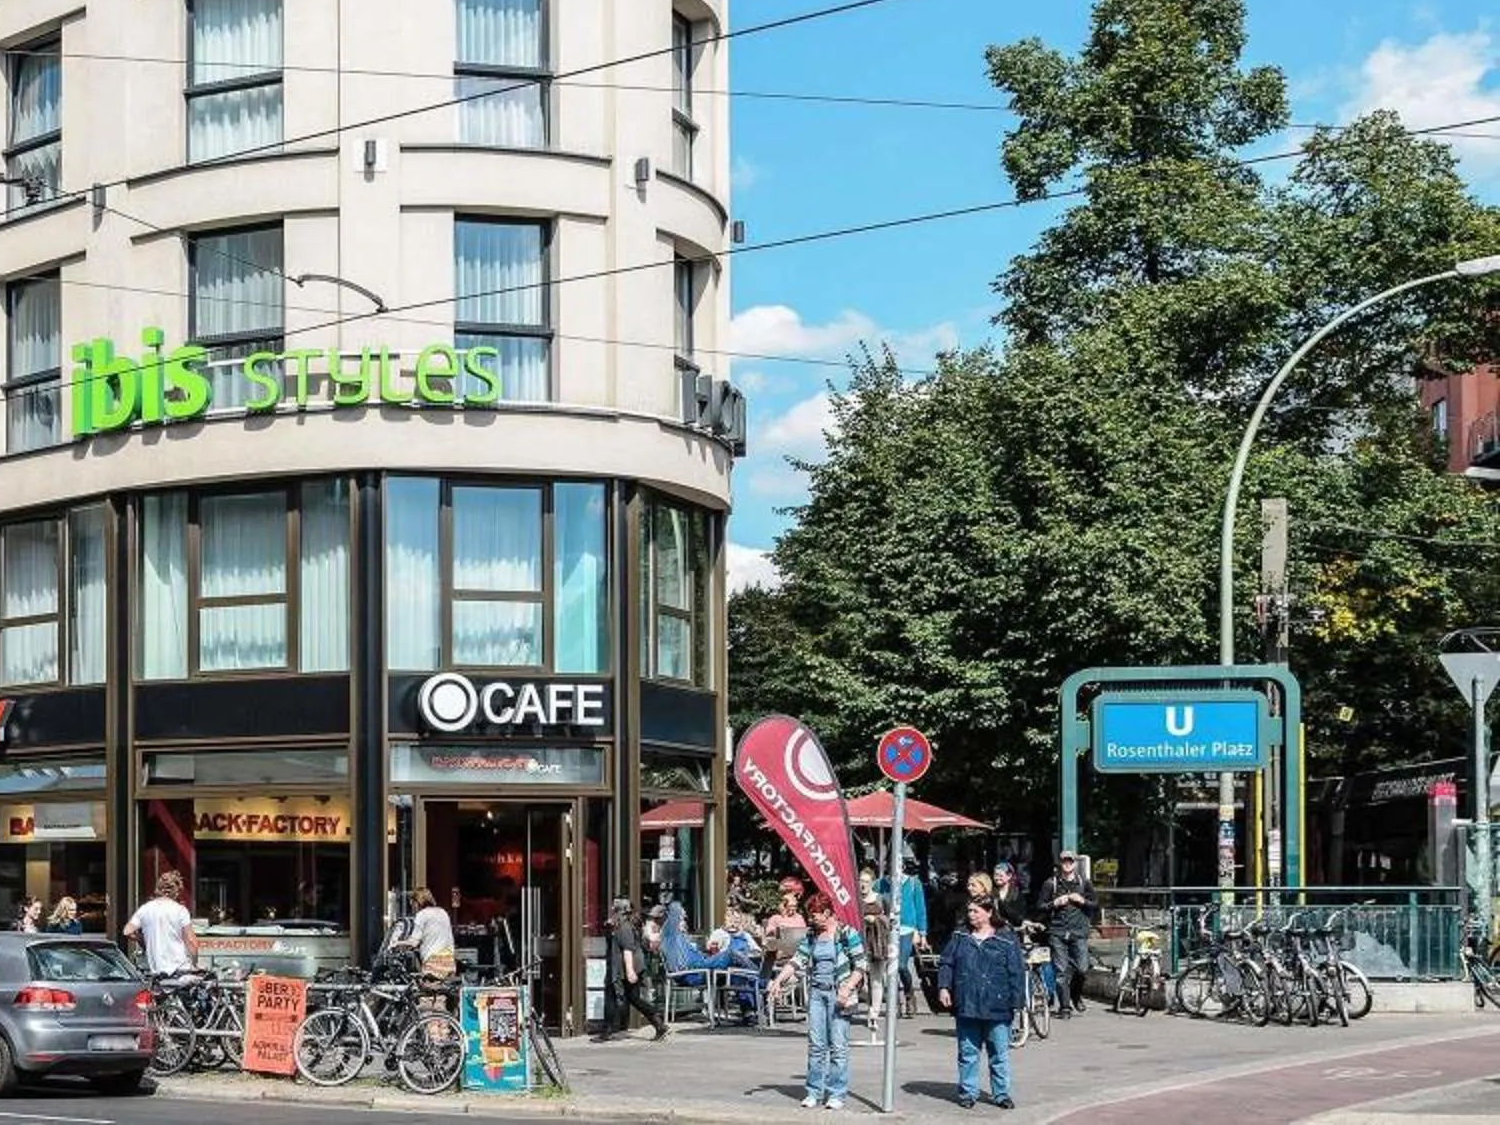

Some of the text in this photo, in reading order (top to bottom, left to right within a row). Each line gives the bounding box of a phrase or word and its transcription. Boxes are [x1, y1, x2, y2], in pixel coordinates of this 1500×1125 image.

[71, 326, 212, 437] ibis
[480, 682, 605, 726] CAFE
[1165, 705, 1194, 737] U
[1106, 741, 1254, 759] Rosenthaler Platz
[257, 995, 301, 1012] PARTY
